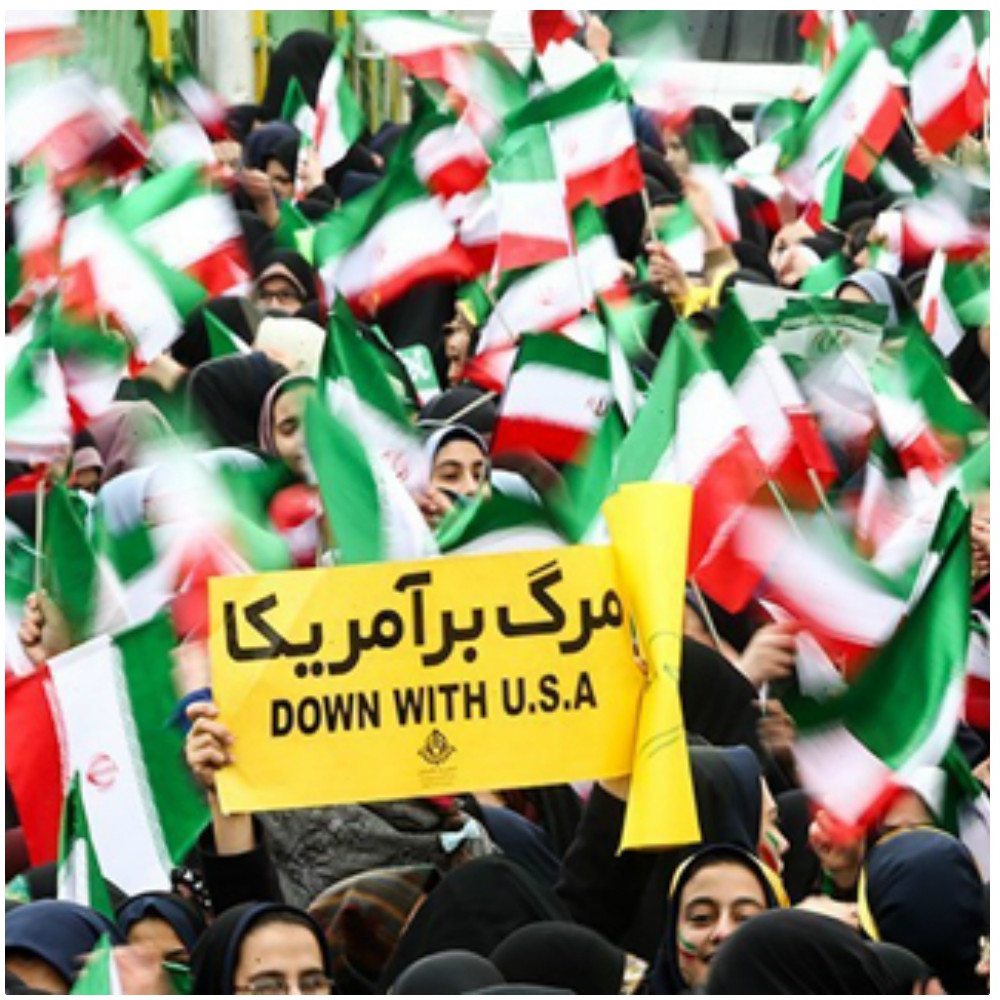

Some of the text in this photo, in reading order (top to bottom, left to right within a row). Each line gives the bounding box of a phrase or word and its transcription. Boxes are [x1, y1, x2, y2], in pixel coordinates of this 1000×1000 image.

[498, 560, 623, 654] مرگ
[270, 671, 597, 737] DOWN WITH U.S.A
